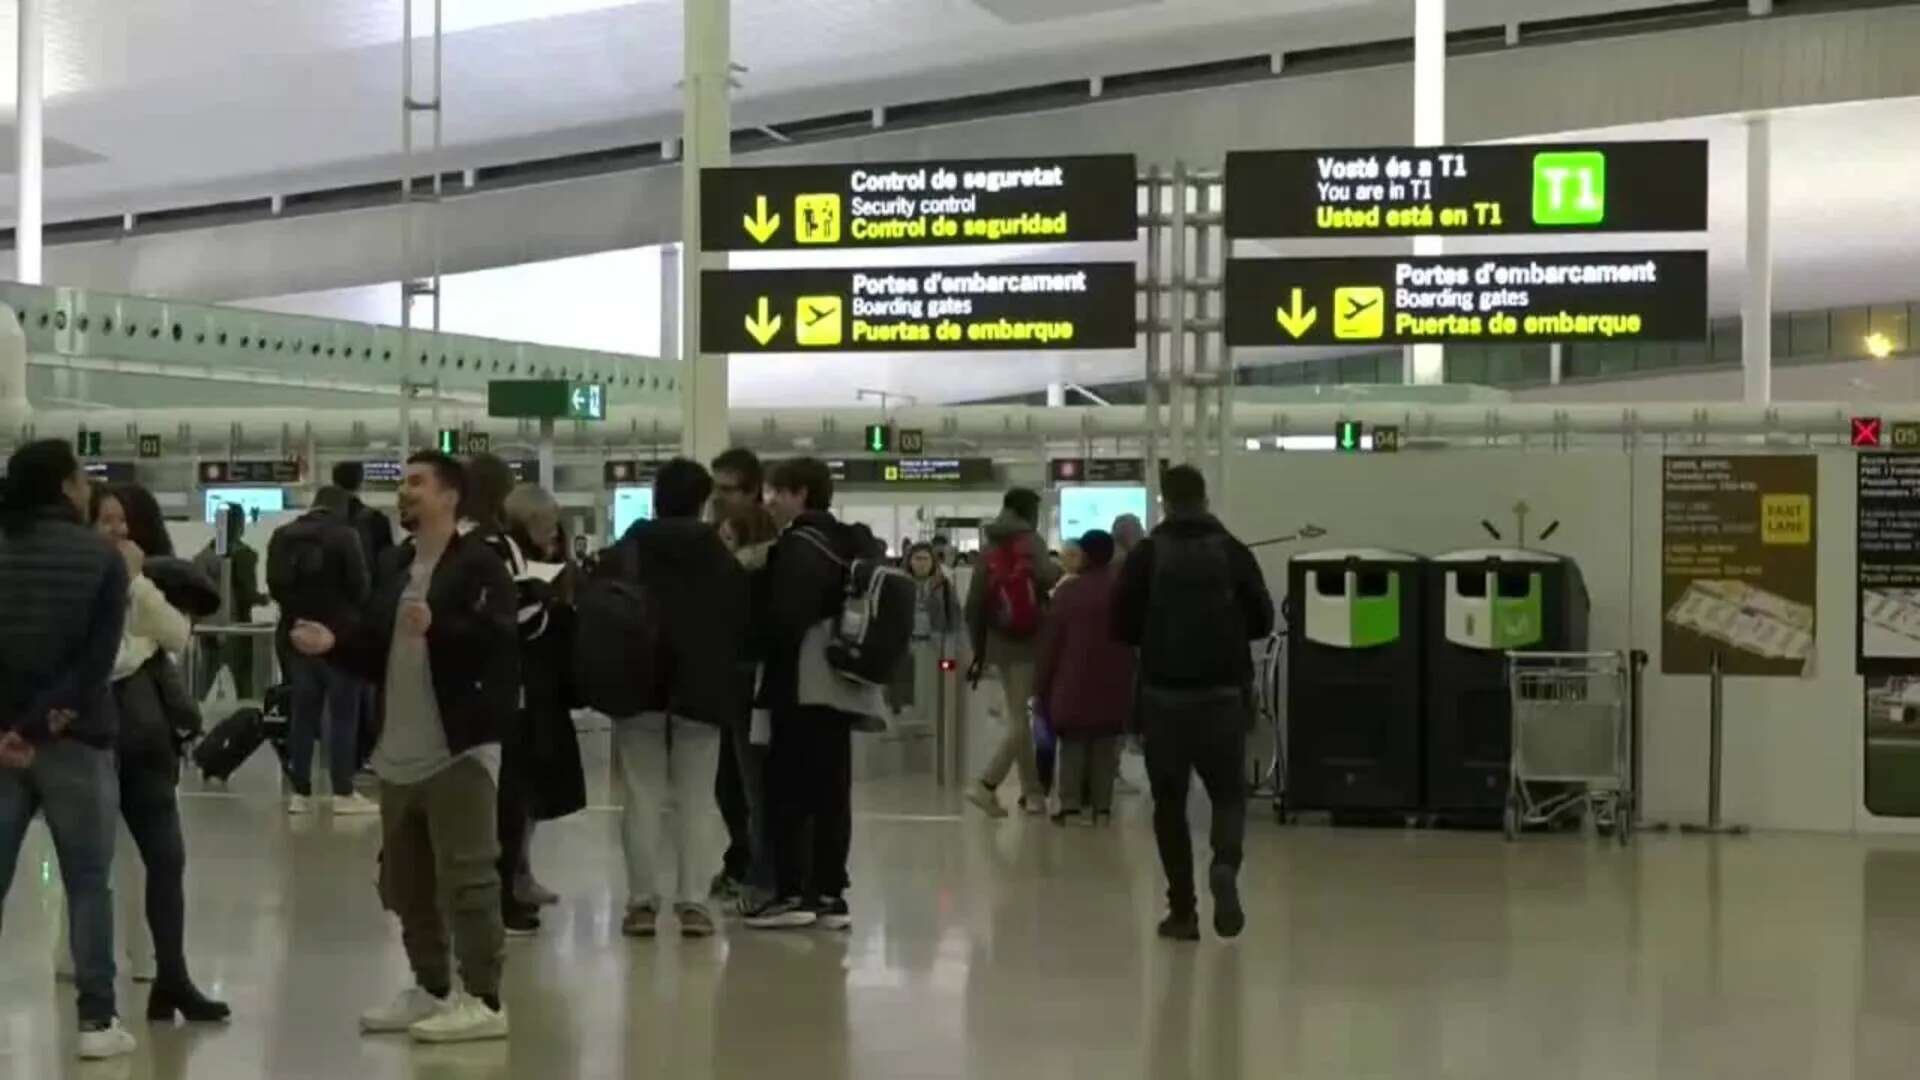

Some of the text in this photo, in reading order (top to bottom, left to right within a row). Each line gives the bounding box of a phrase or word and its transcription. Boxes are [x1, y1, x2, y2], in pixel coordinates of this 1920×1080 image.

[1317, 154, 1467, 179] Vosté és a T1
[851, 167, 1064, 192] Control de seguretat
[1317, 180, 1432, 201] You are in T1
[1543, 167, 1602, 210] T1
[852, 193, 976, 218] Security control
[1317, 202, 1502, 228] Usted está en T1
[851, 212, 1067, 239] Control de seguridad
[853, 271, 1087, 295] Portes d'embarcament
[1396, 260, 1656, 286] Portes d'embarcament
[853, 296, 973, 318] Boarding gates
[1396, 288, 1529, 311] Boarding gates
[852, 318, 1073, 343] Puertas de embarque
[1396, 311, 1641, 336] Puertas de embarque
[144, 440, 157, 453] 01
[1376, 432, 1393, 448] 04
